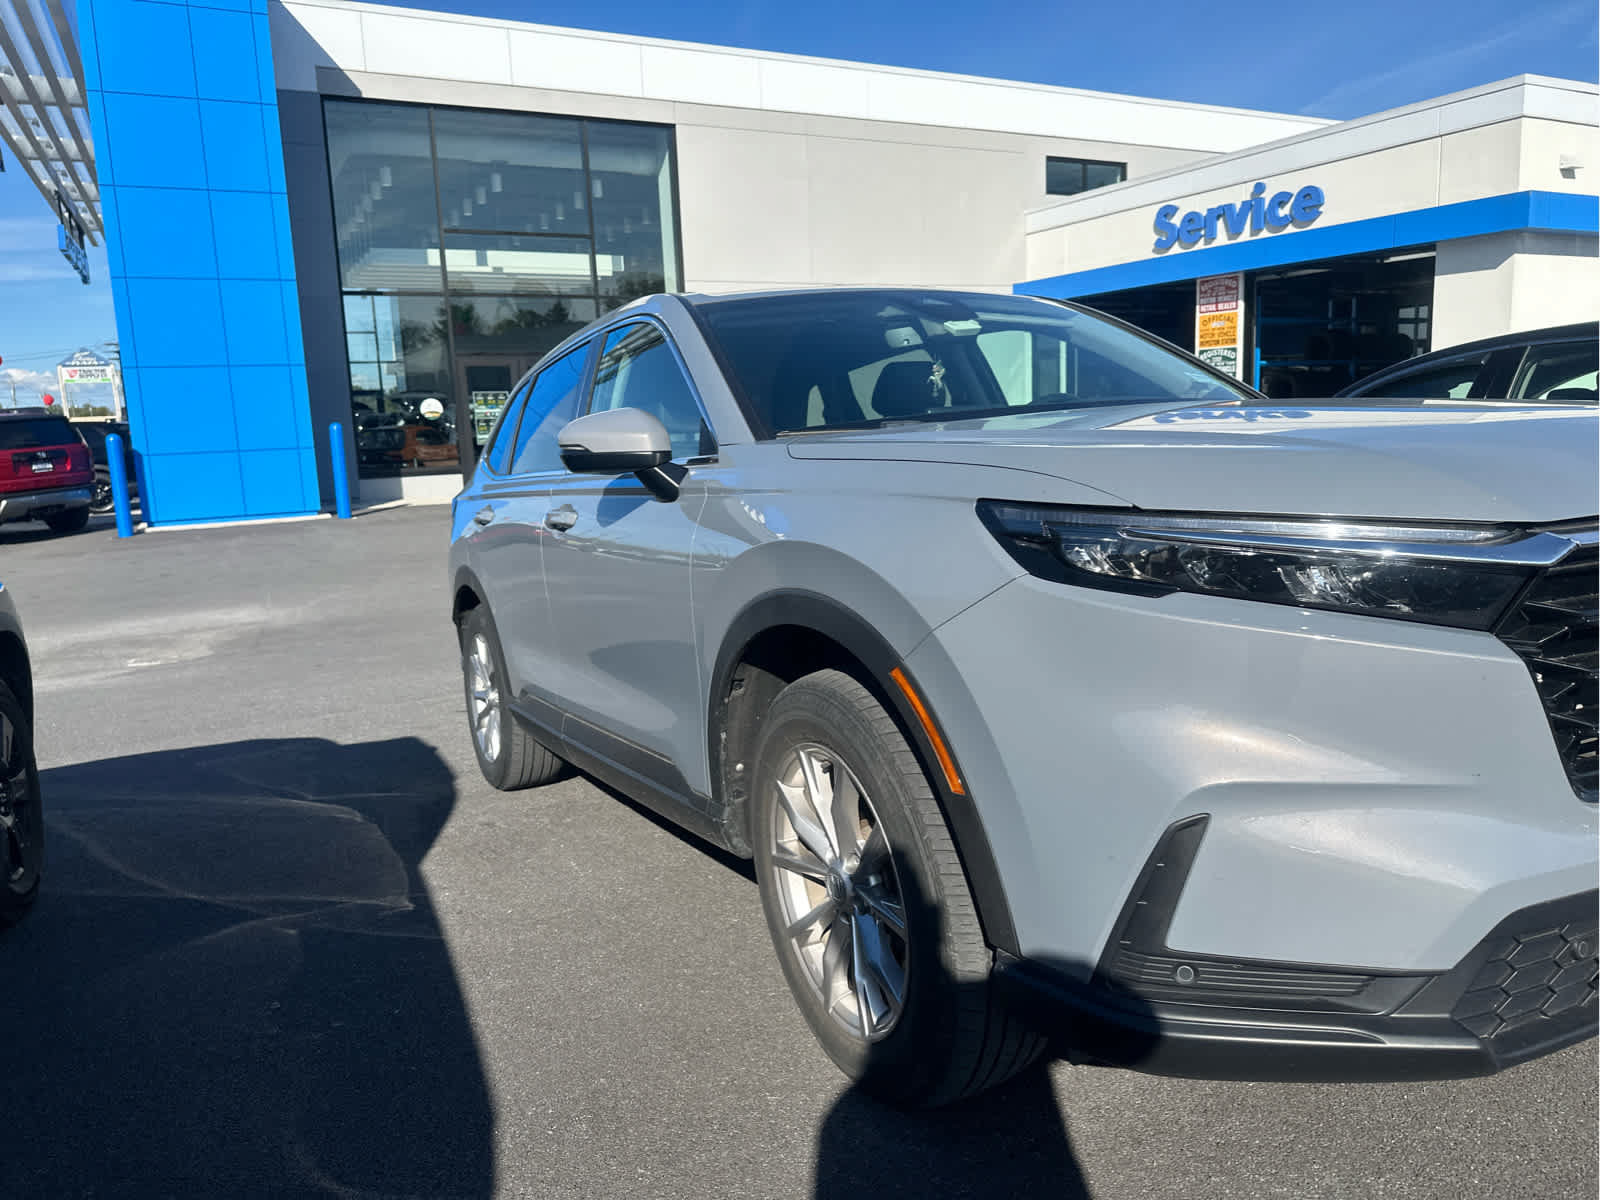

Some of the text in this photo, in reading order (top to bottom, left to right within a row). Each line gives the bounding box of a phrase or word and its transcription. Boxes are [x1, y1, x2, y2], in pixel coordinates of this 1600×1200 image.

[1154, 182, 1325, 252] Service
[1202, 314, 1234, 326] OFFICIAL
[1200, 350, 1236, 361] REGISTERED
